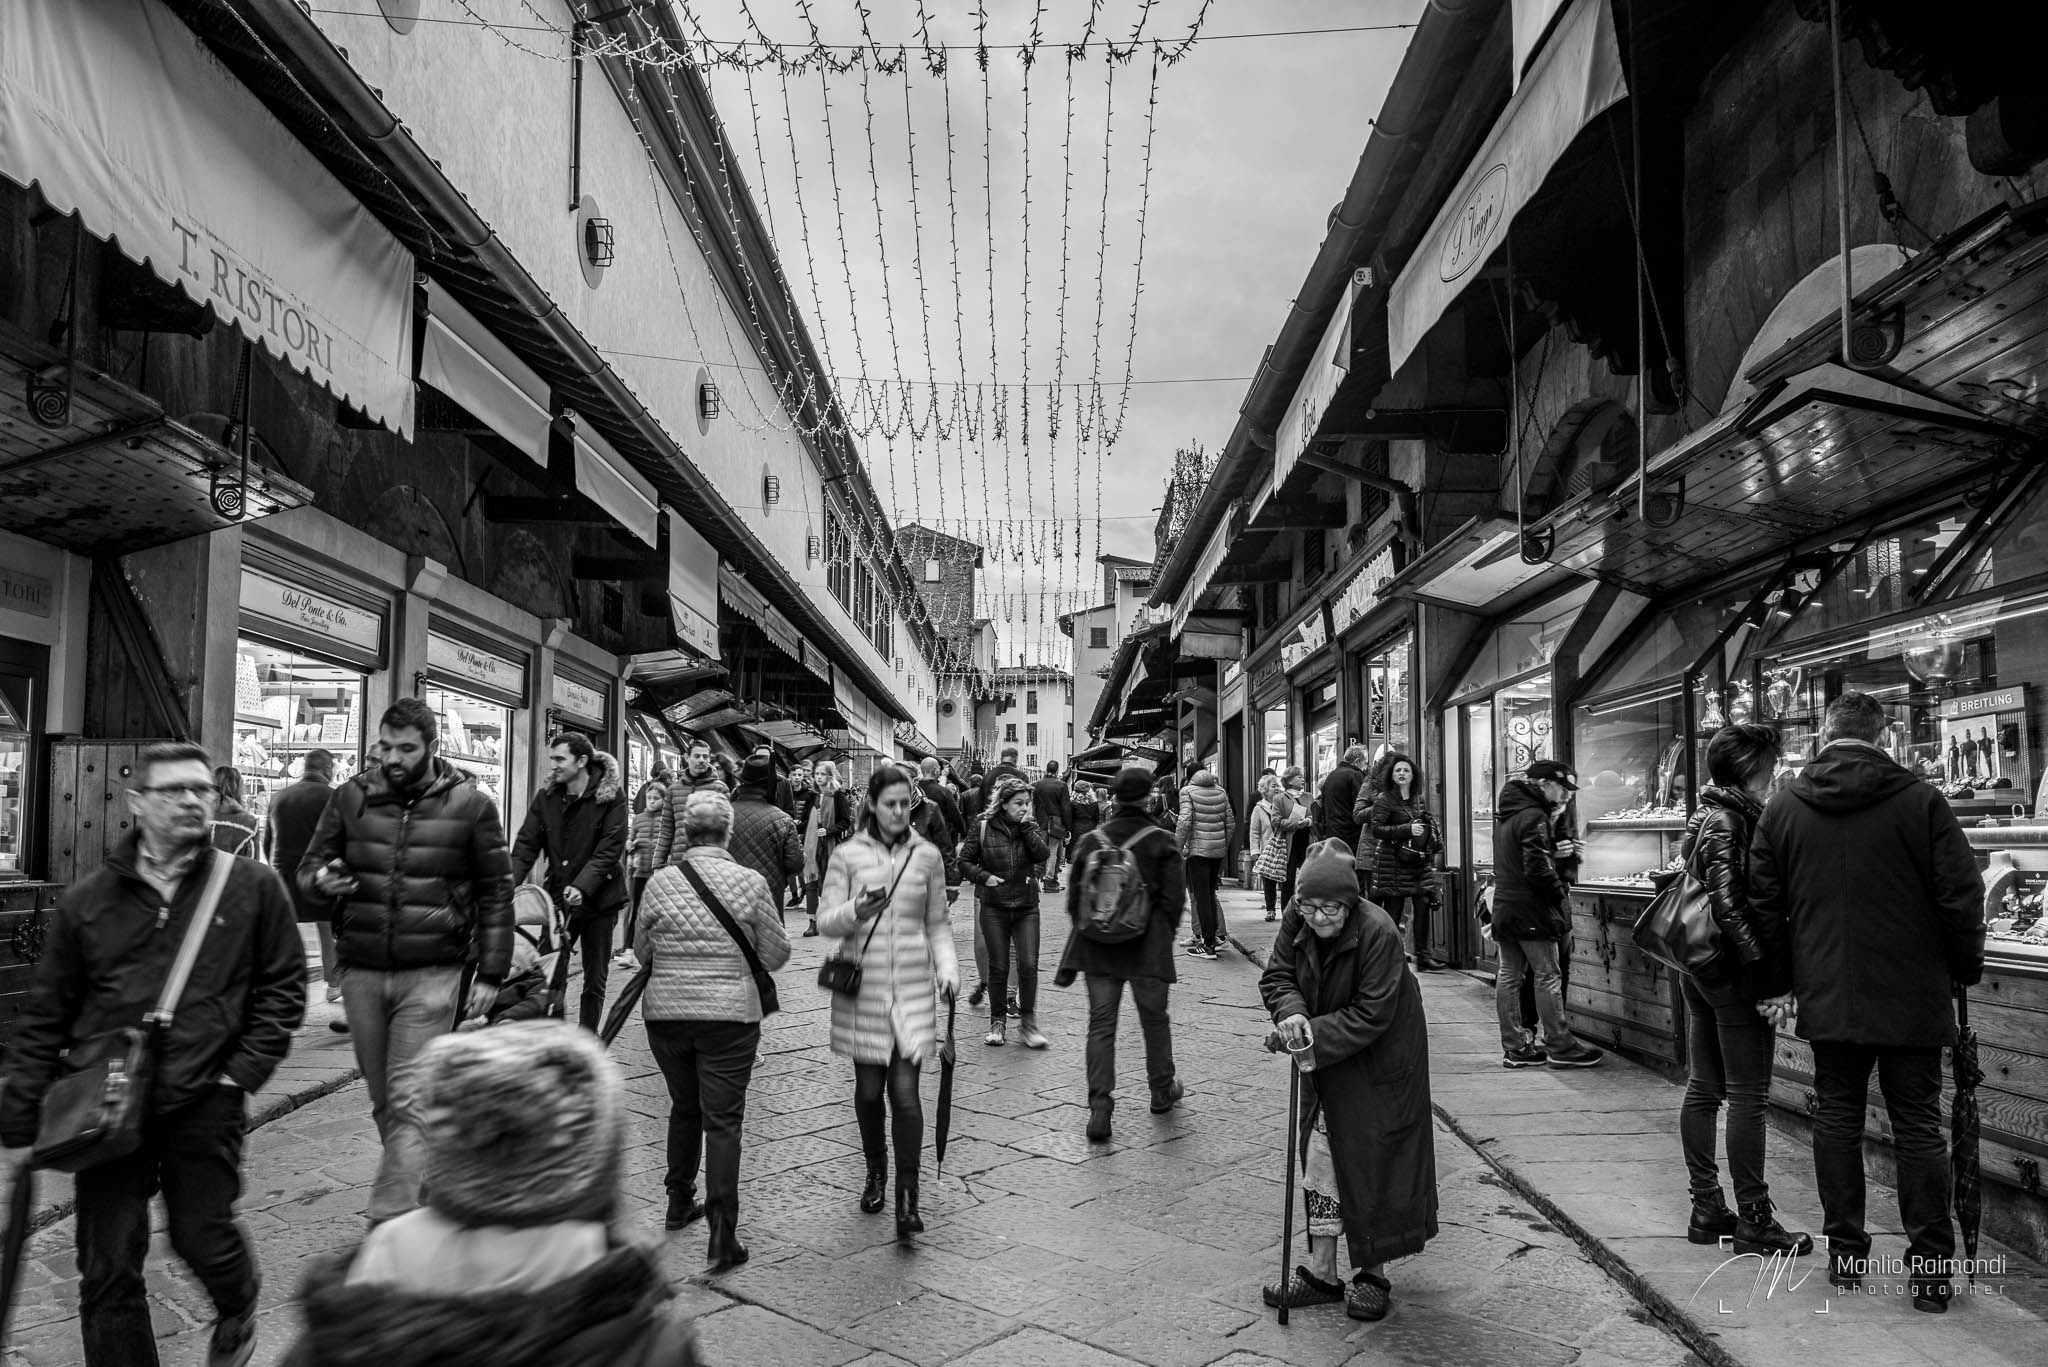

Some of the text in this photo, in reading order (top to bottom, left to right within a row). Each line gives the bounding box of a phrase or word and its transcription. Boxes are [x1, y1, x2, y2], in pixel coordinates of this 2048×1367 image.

[1468, 192, 1494, 248] Vaggi
[172, 217, 333, 374] T. RISTORI
[281, 589, 301, 609] Del
[300, 596, 325, 618] Ponte
[326, 609, 334, 622] &
[457, 649, 469, 662] Del
[468, 652, 482, 668] Ponte
[1961, 694, 2013, 712] BREITLING
